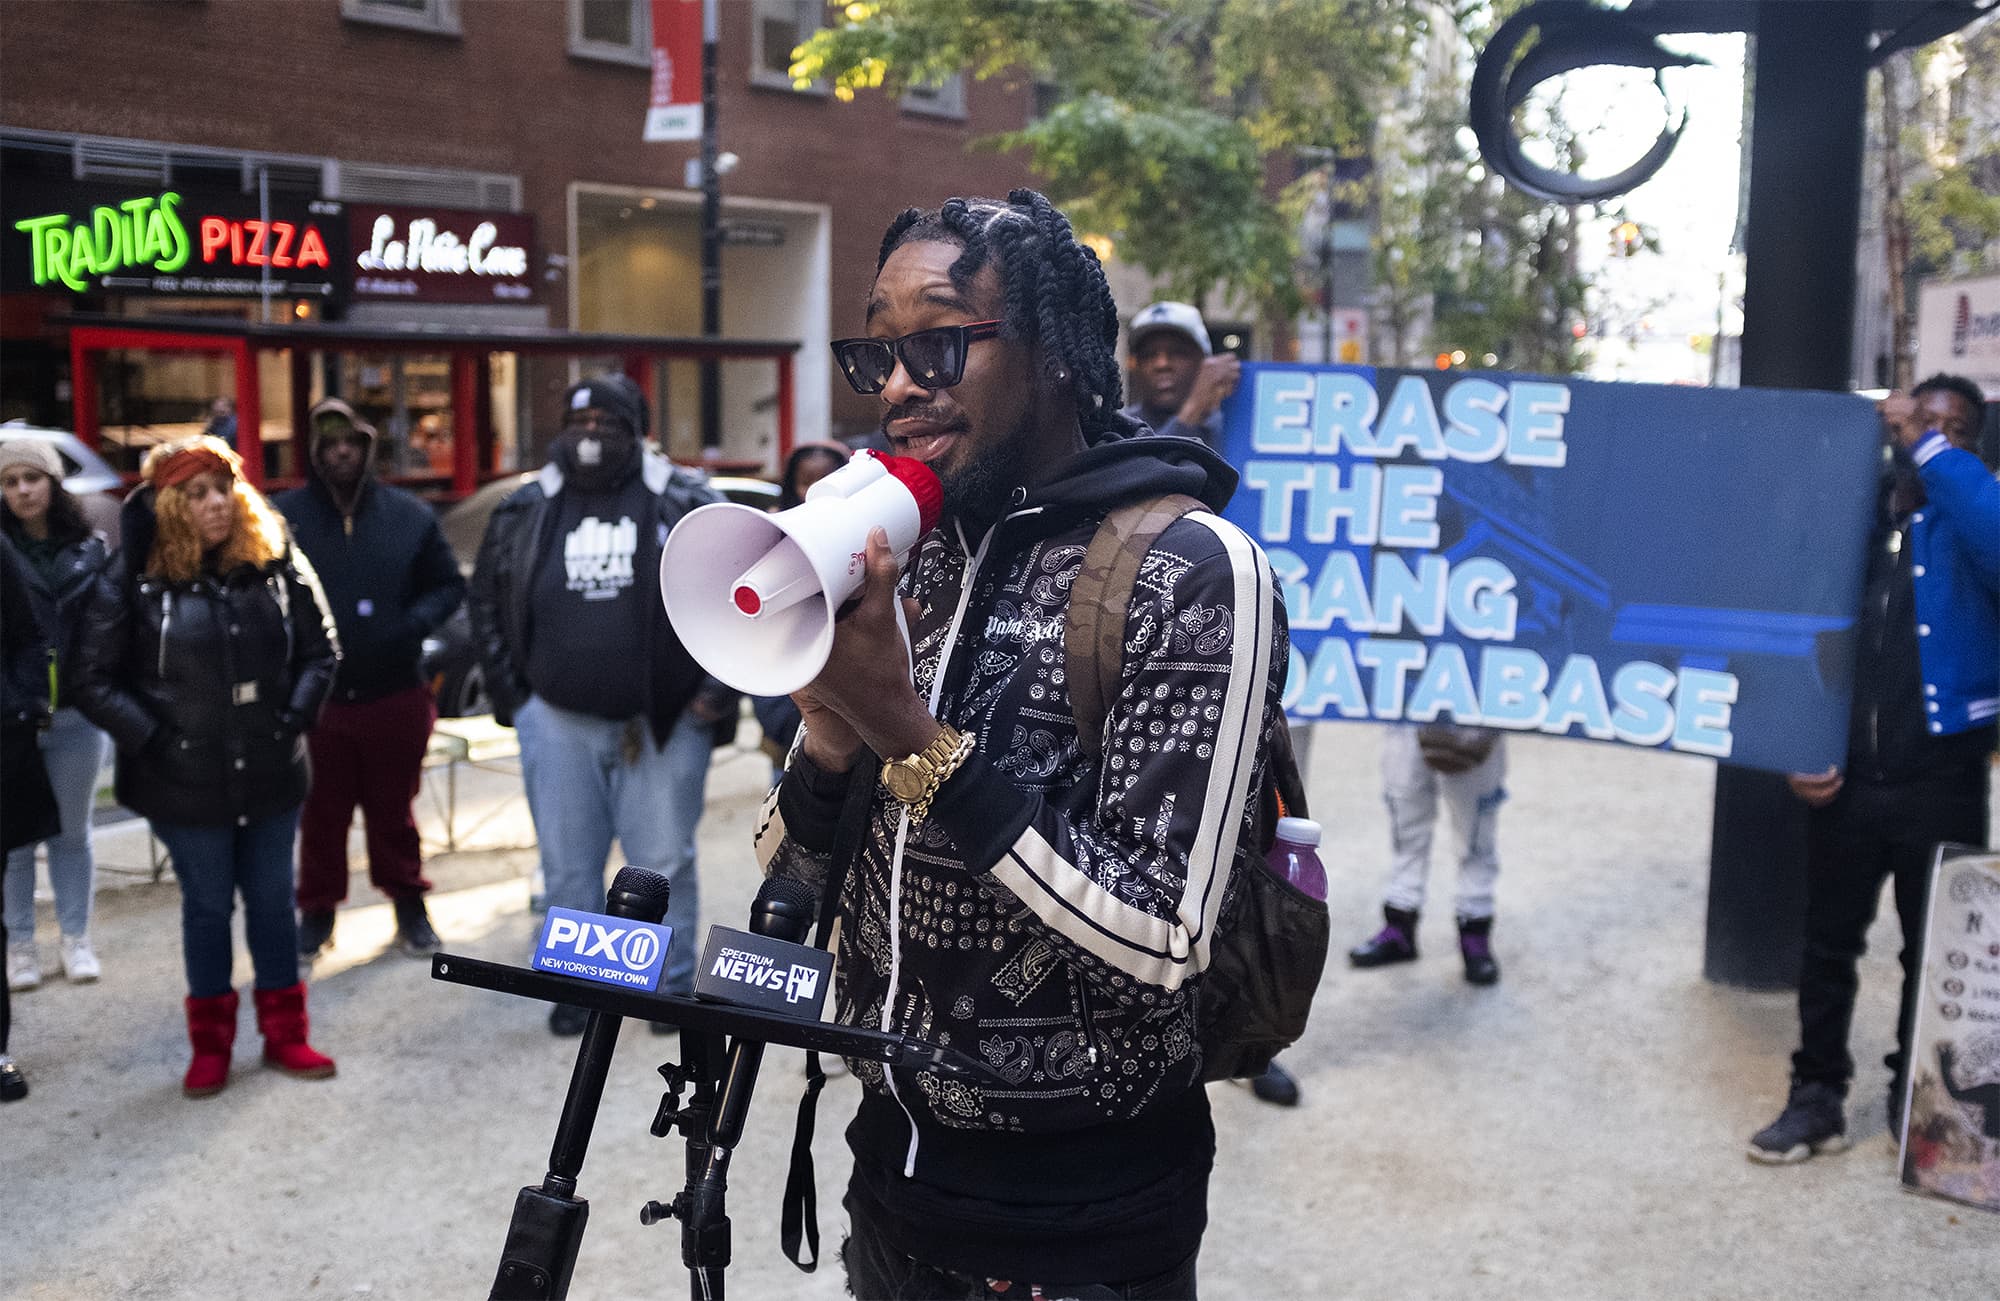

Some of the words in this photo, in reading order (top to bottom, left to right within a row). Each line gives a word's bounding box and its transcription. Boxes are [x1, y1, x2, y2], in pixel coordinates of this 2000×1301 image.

[15, 192, 190, 292] TRADITAS
[201, 216, 330, 268] PIZZA
[1250, 370, 1571, 467] ERASE
[1245, 461, 1444, 548] THE
[546, 917, 627, 962] PIX
[719, 947, 774, 968] SPECTRUM
[541, 957, 565, 969] NEW
[598, 967, 625, 981] VERY
[624, 973, 649, 986] OWN
[710, 956, 788, 991] NEWS
[793, 967, 817, 982] NY
